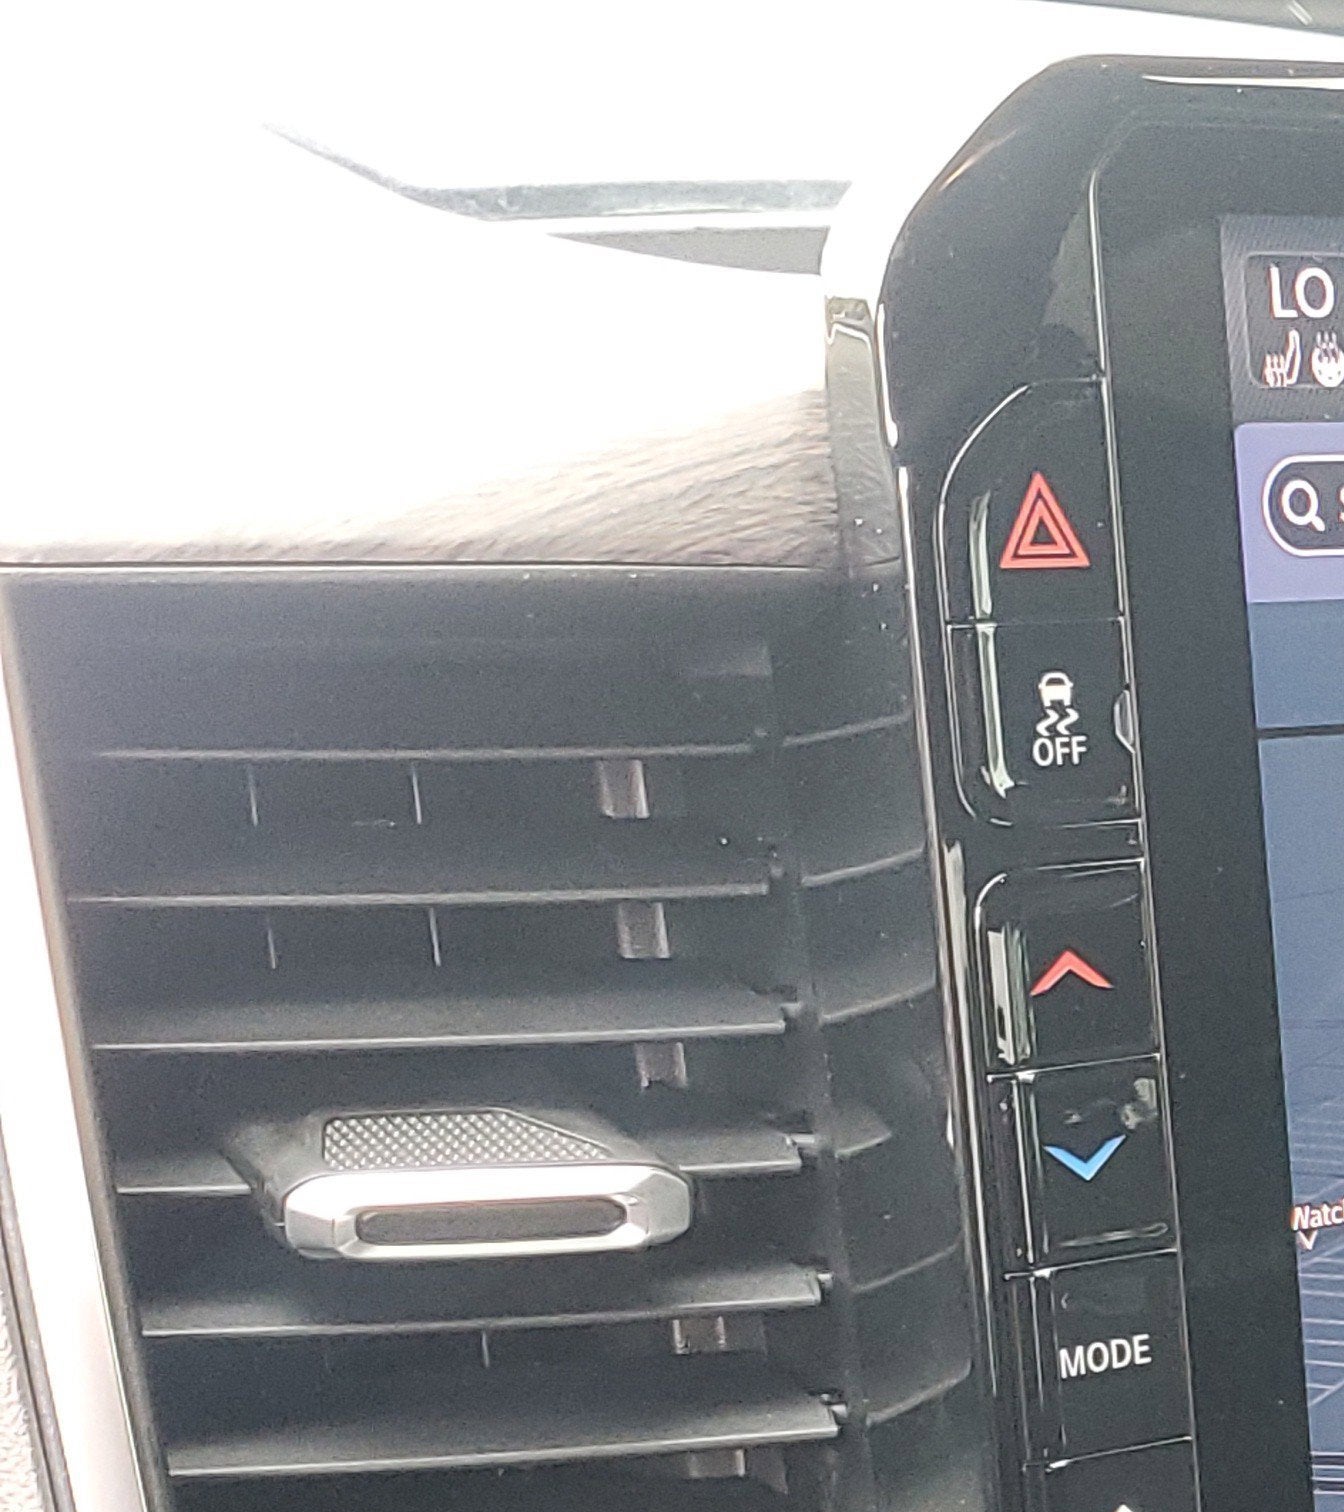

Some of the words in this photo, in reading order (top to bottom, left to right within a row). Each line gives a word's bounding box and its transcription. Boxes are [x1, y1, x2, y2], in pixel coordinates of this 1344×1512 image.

[1270, 266, 1335, 319] LO
[1033, 735, 1088, 767] OFF
[1059, 1333, 1152, 1379] MODE
